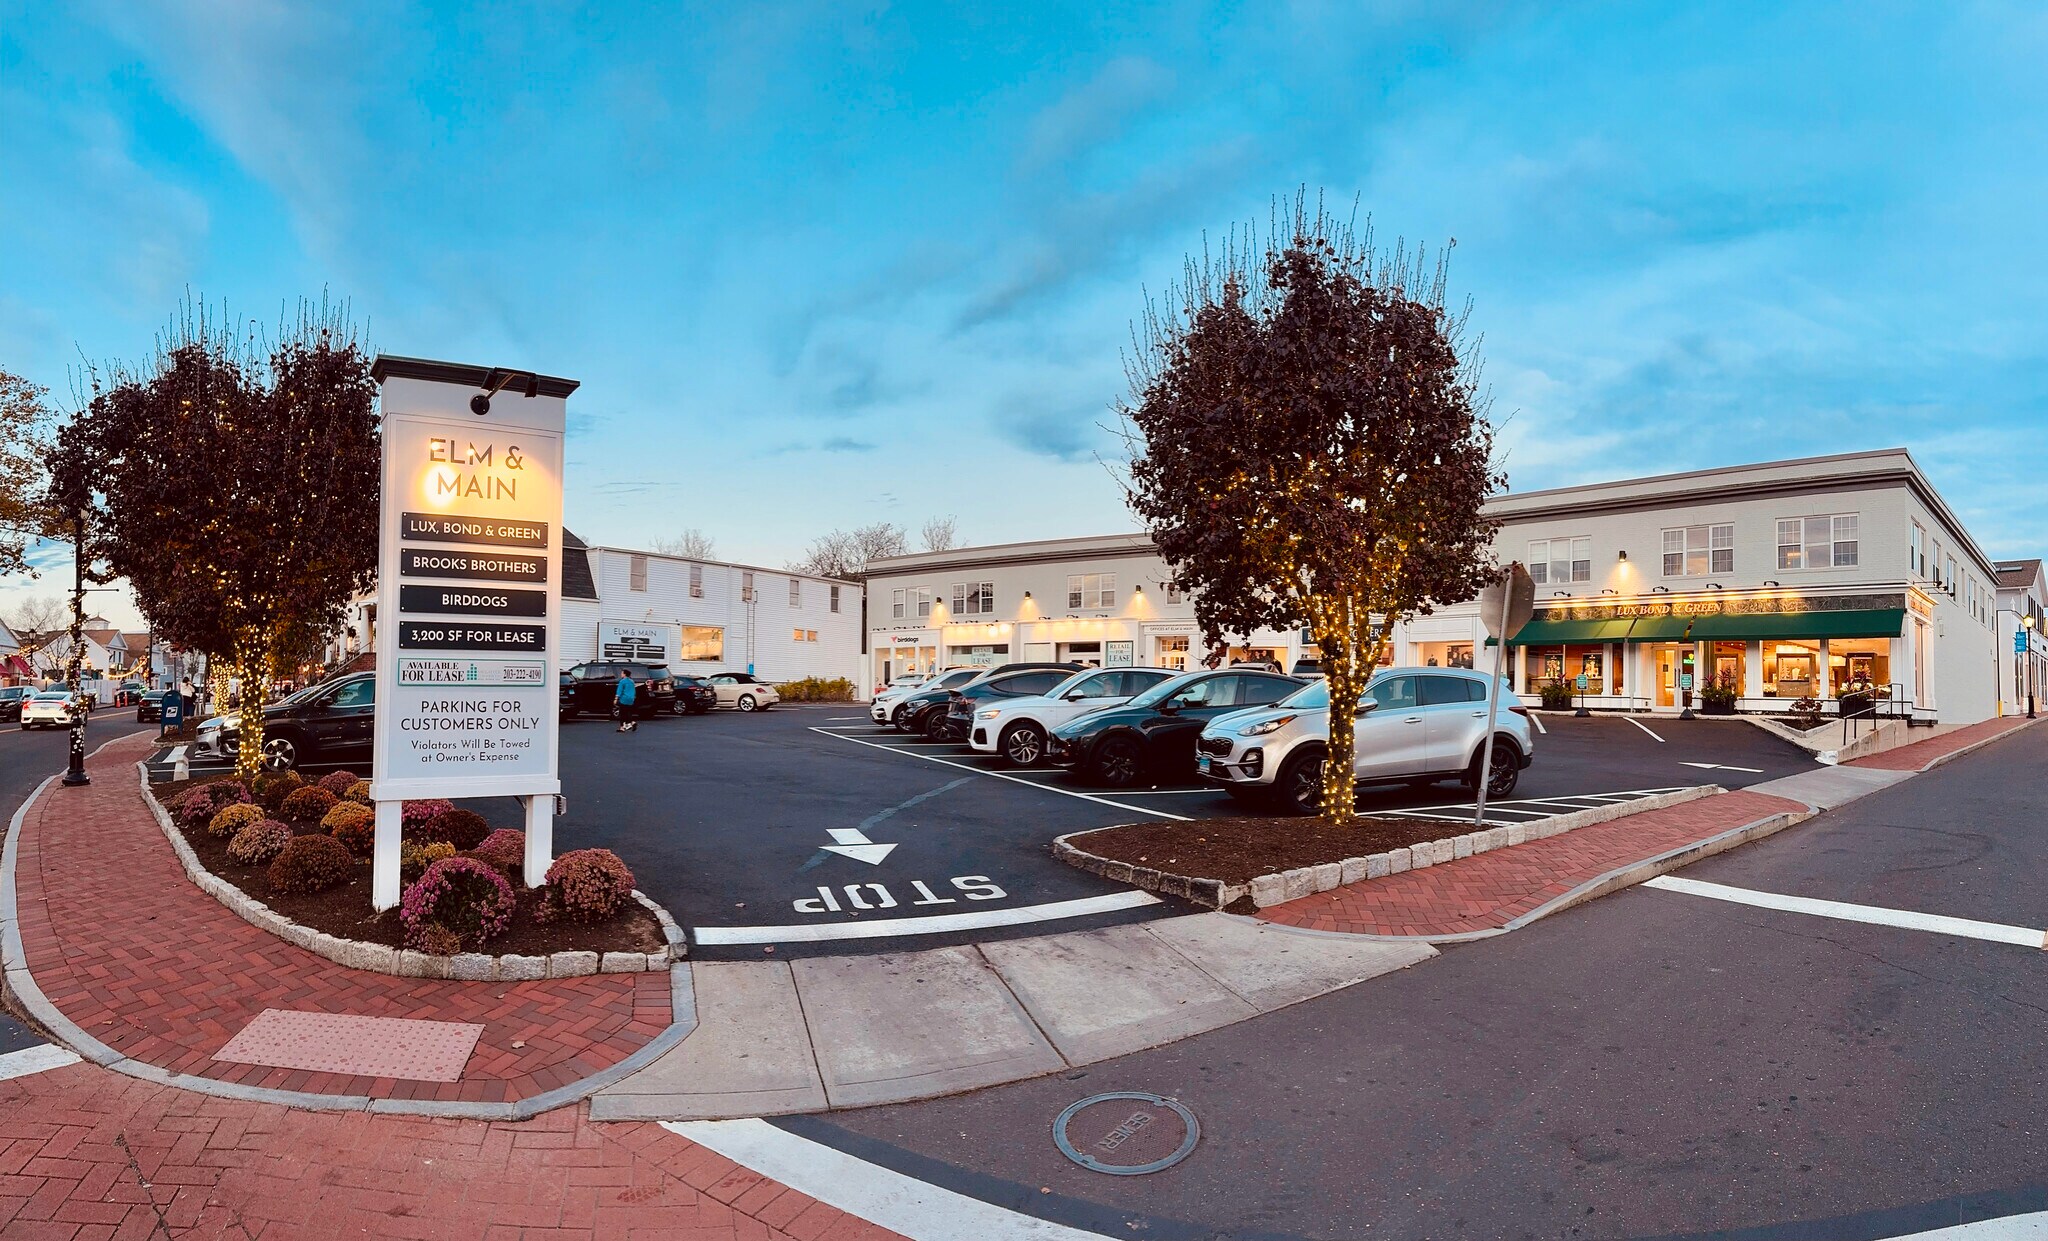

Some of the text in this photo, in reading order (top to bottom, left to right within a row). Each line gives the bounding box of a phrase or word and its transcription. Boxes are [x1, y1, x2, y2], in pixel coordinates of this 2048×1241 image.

[430, 438, 524, 470] ELM &
[437, 472, 516, 501] MAIN
[410, 520, 541, 540] LUX, BOND & GREEN
[413, 556, 537, 574] BROOKS BROTHERS
[442, 594, 508, 607] BIRDDOGS
[1617, 602, 1722, 616] LUX BOND & GREEN
[411, 629, 535, 643] 3,200 SF FOR LEASE
[613, 627, 629, 636] ELM
[897, 636, 919, 644] birddogs
[402, 670, 424, 681] FOR
[429, 670, 465, 681] LEASE
[503, 669, 542, 680] 203-222-4190
[421, 700, 521, 713] PARKING FOR
[401, 717, 540, 730] CUSTOMERS ONLY
[411, 738, 530, 750] Violators Will Be Towed
[421, 752, 519, 763] at Owner's Expense
[792, 875, 1008, 913] STOP
[1099, 1111, 1151, 1149] SEWER
